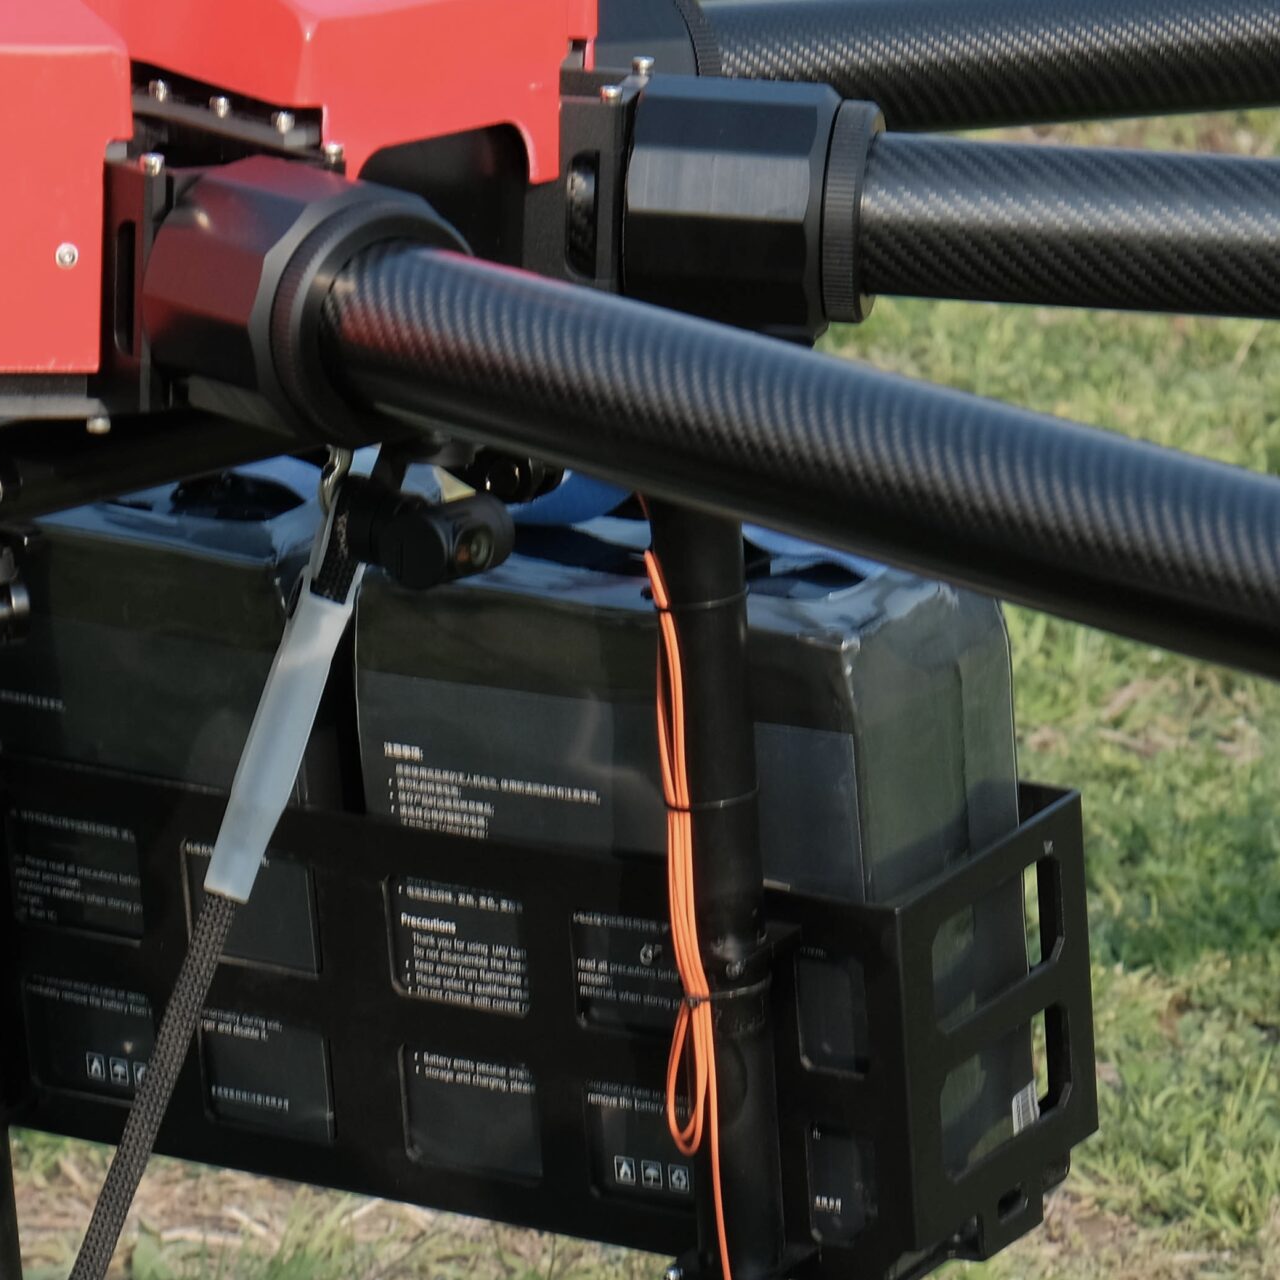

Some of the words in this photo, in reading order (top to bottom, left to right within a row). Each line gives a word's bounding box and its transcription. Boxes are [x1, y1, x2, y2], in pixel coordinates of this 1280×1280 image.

[400, 912, 457, 935] Precautions
[412, 931, 435, 948] Thank
[437, 936, 452, 952] you
[453, 937, 465, 952] for
[467, 940, 488, 957] using
[414, 958, 434, 974] Keep
[577, 957, 596, 971] read
[598, 959, 608, 973] all
[423, 1051, 452, 1070] Battery
[455, 1071, 471, 1085] and
[587, 1092, 618, 1109] remove
